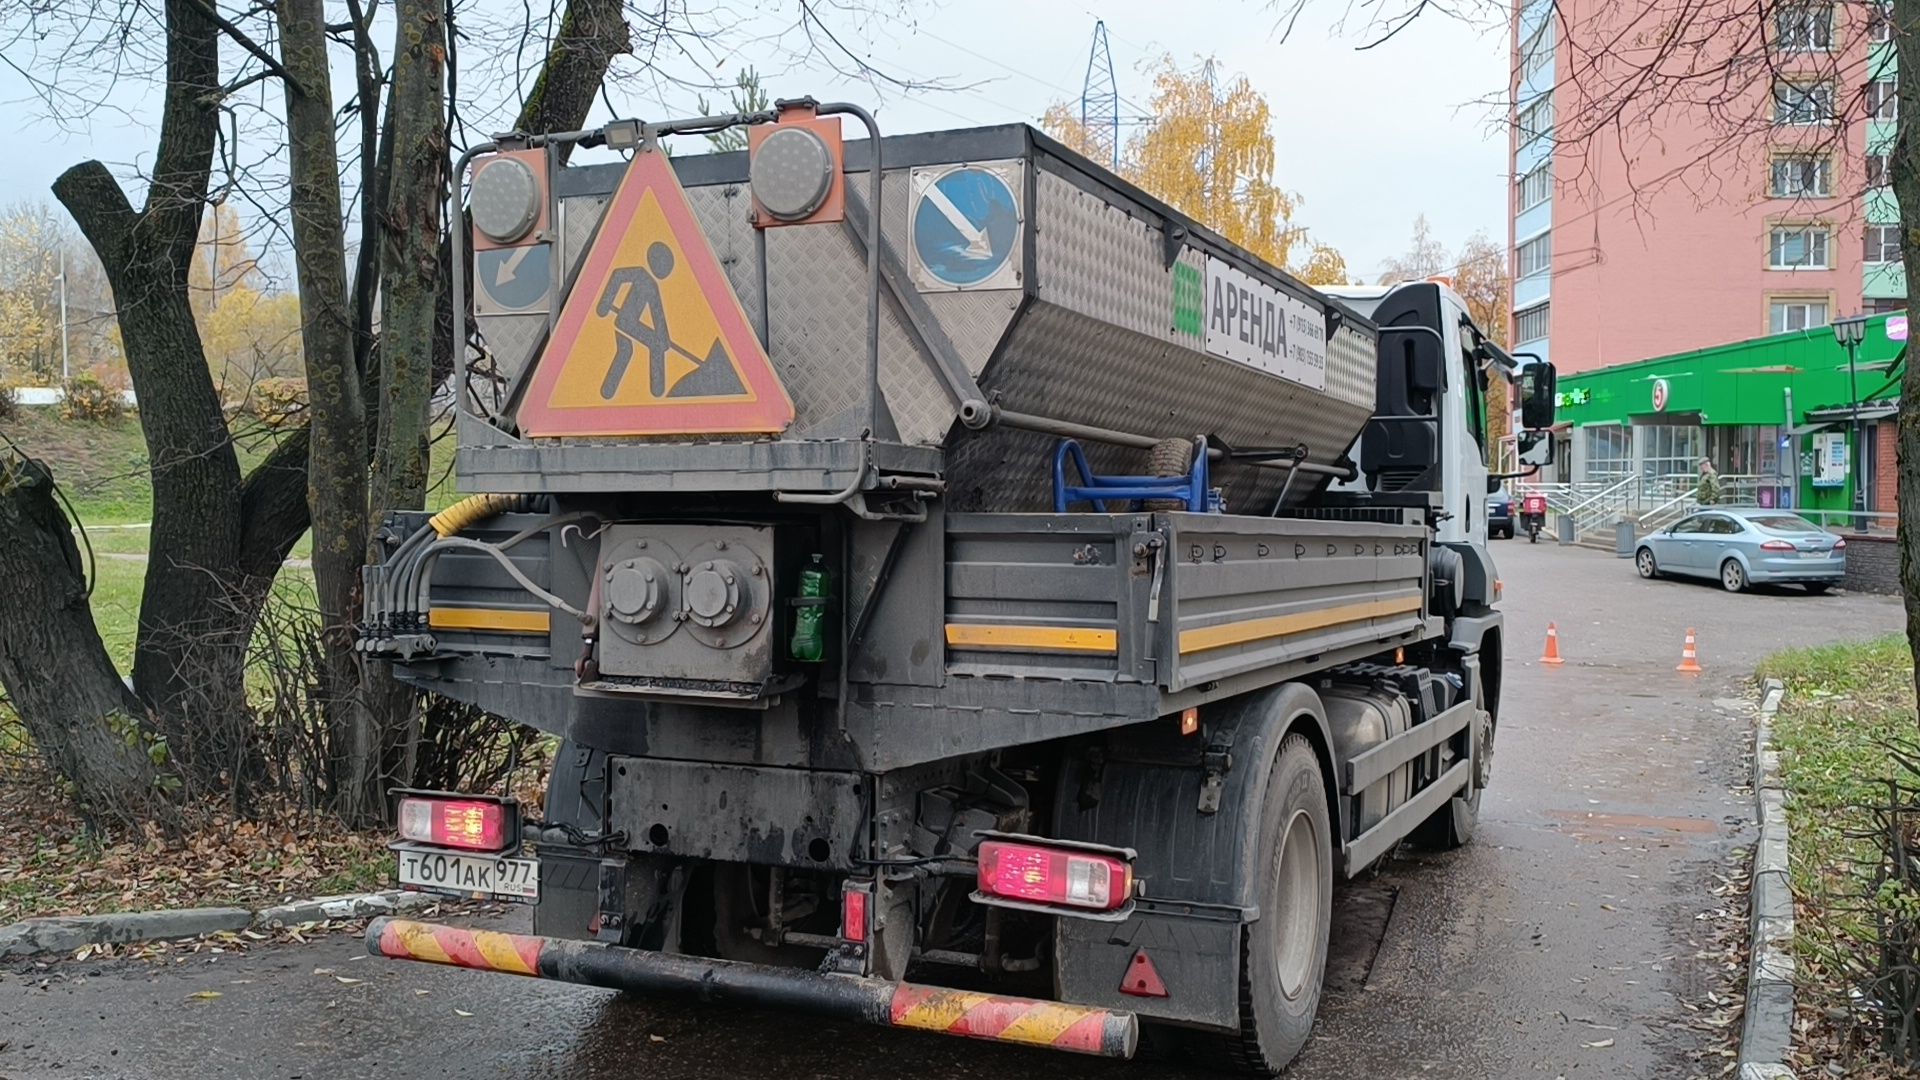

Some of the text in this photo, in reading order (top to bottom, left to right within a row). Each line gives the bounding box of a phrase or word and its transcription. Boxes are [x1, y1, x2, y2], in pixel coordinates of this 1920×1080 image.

[1211, 276, 1287, 358] АРЕНДА
[407, 854, 531, 888] Т601АК 977
[504, 883, 522, 893] RUS
